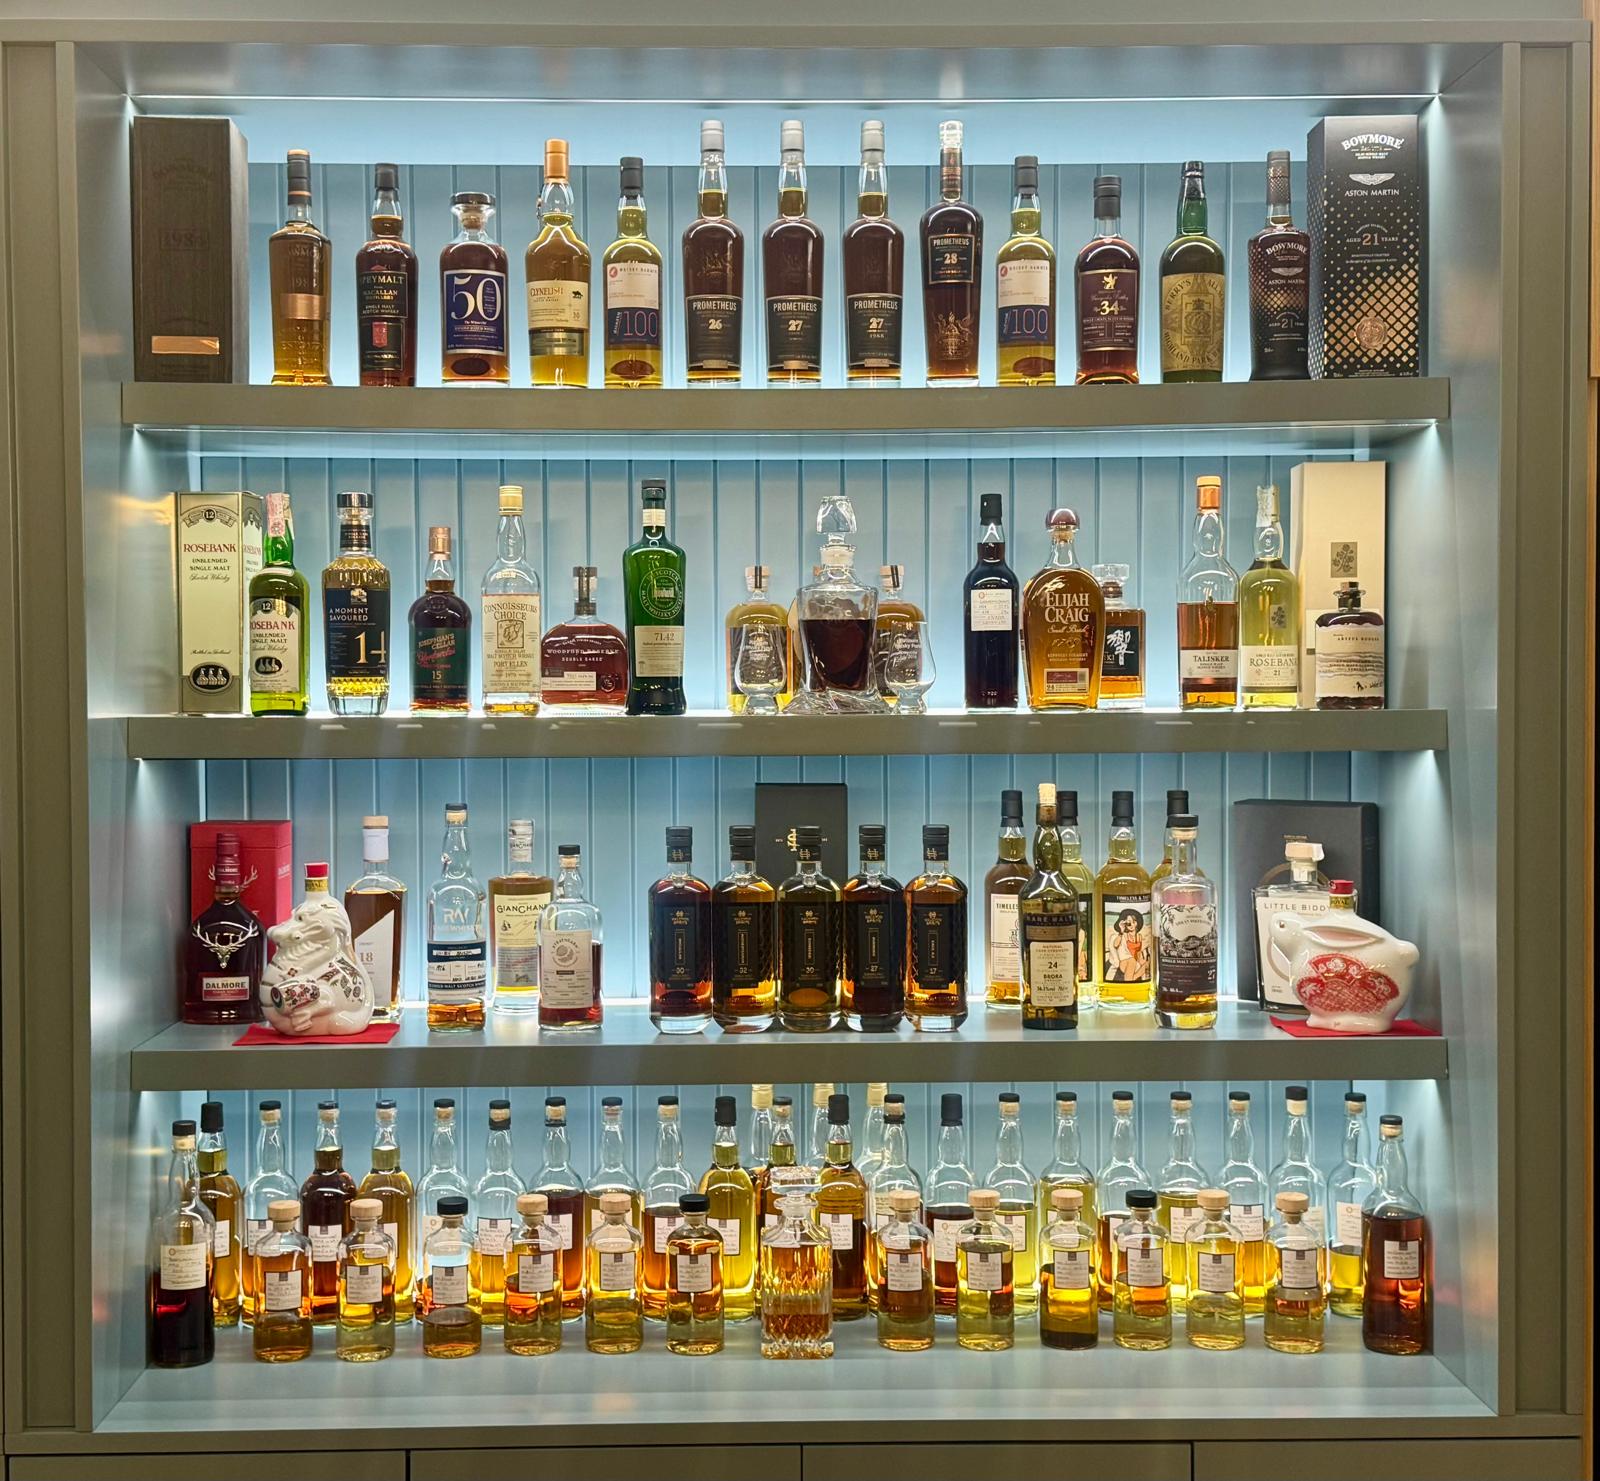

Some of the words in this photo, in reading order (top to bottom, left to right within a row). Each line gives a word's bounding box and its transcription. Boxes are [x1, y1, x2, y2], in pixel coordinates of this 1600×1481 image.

[1341, 134, 1404, 150] BOWMORE
[934, 238, 969, 246] PROMETHEUS
[1363, 233, 1379, 246] 21
[1266, 242, 1308, 255] BOWMORE
[944, 253, 958, 264] 28
[530, 287, 564, 297] CLYNELISH
[450, 274, 502, 321] 50
[693, 301, 736, 311] PROMETHEUS
[774, 303, 817, 312] PROMETHEUS
[854, 300, 898, 310] PROMETHEUS
[1100, 301, 1120, 316] 34
[709, 319, 722, 330] 26
[788, 320, 803, 331] 27
[870, 318, 884, 329] 27
[1281, 319, 1293, 328] 21
[1164, 332, 1189, 362] HIGHLAND
[184, 544, 236, 553] ROSEBANK
[211, 574, 230, 583] Whisky
[1046, 592, 1089, 609] ELIJAH
[484, 602, 537, 614] CONNOISSEURS
[494, 611, 526, 620] CHOICE
[1045, 608, 1089, 623] CRAIG
[251, 621, 295, 630] OSEBANK
[1048, 625, 1067, 633] Small
[354, 631, 386, 663] 14
[432, 671, 441, 680] 15
[497, 904, 546, 913] GIANCHAN
[359, 952, 373, 962] 18
